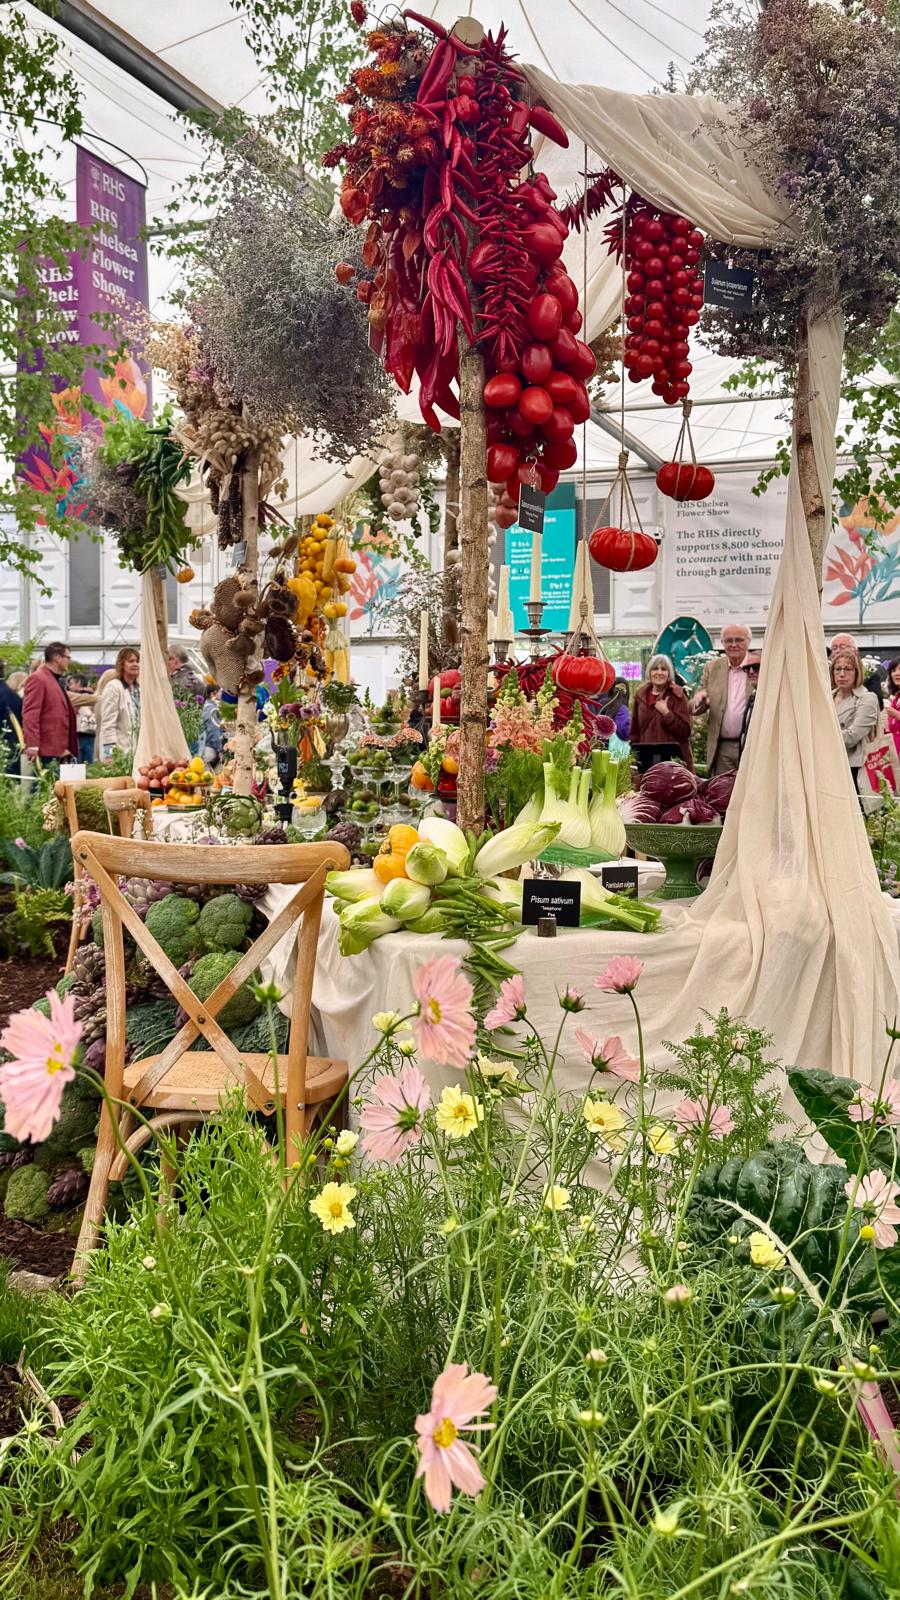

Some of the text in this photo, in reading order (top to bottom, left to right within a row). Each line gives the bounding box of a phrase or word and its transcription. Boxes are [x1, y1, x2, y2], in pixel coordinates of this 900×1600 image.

[102, 172, 126, 202] RHS
[90, 200, 118, 229] RHS
[92, 250, 135, 282] Flower
[92, 270, 127, 300] Show
[40, 285, 79, 302] hels
[676, 500, 729, 509] RHS Chelsea
[676, 509, 730, 518] Flower Show
[676, 527, 762, 539] The RHS directly
[676, 539, 784, 553] supports 8,800 school
[676, 556, 687, 564] to
[688, 554, 728, 563] connect
[730, 553, 753, 562] with
[676, 565, 772, 578] through gardening
[530, 895, 574, 905] Pisum sativum
